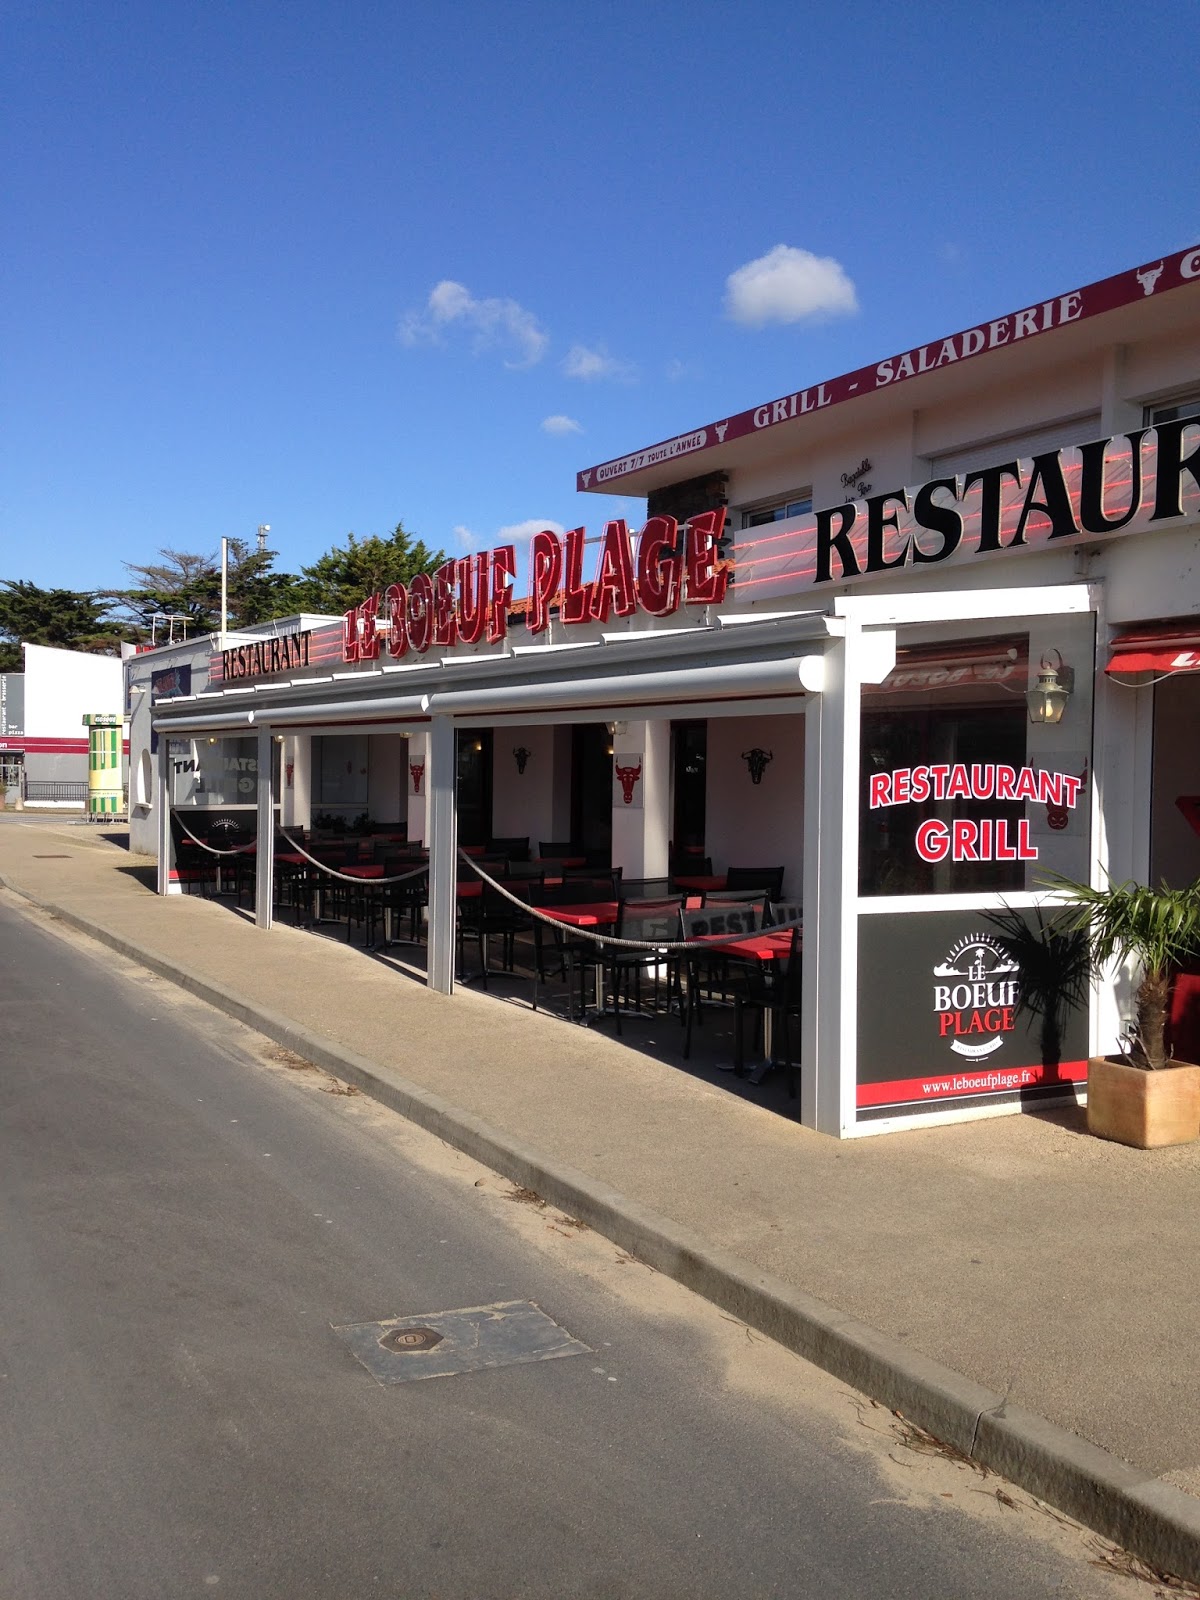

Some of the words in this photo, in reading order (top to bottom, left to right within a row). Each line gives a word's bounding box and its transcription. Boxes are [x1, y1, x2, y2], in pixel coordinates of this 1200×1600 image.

[753, 383, 832, 428] GRILL
[875, 291, 1083, 387] SALADERIE
[600, 462, 628, 479] OUVERT
[630, 454, 645, 470] 7/7
[648, 449, 667, 463] TOUTE
[670, 432, 701, 455] L'ANNÉE
[813, 415, 1200, 584] RESTAUR
[342, 592, 380, 663] LE
[385, 544, 517, 660] BOEUF
[526, 506, 728, 635] PLAGE
[222, 630, 312, 681] RESTAURANT
[870, 764, 1081, 809] RESTAURANT
[915, 818, 1038, 863] GRILL
[968, 965, 987, 981] LE
[934, 981, 1020, 1012] BOEUF
[939, 1007, 1015, 1036] PLAGE
[922, 1069, 1030, 1094] www.leboeufplage.fr
